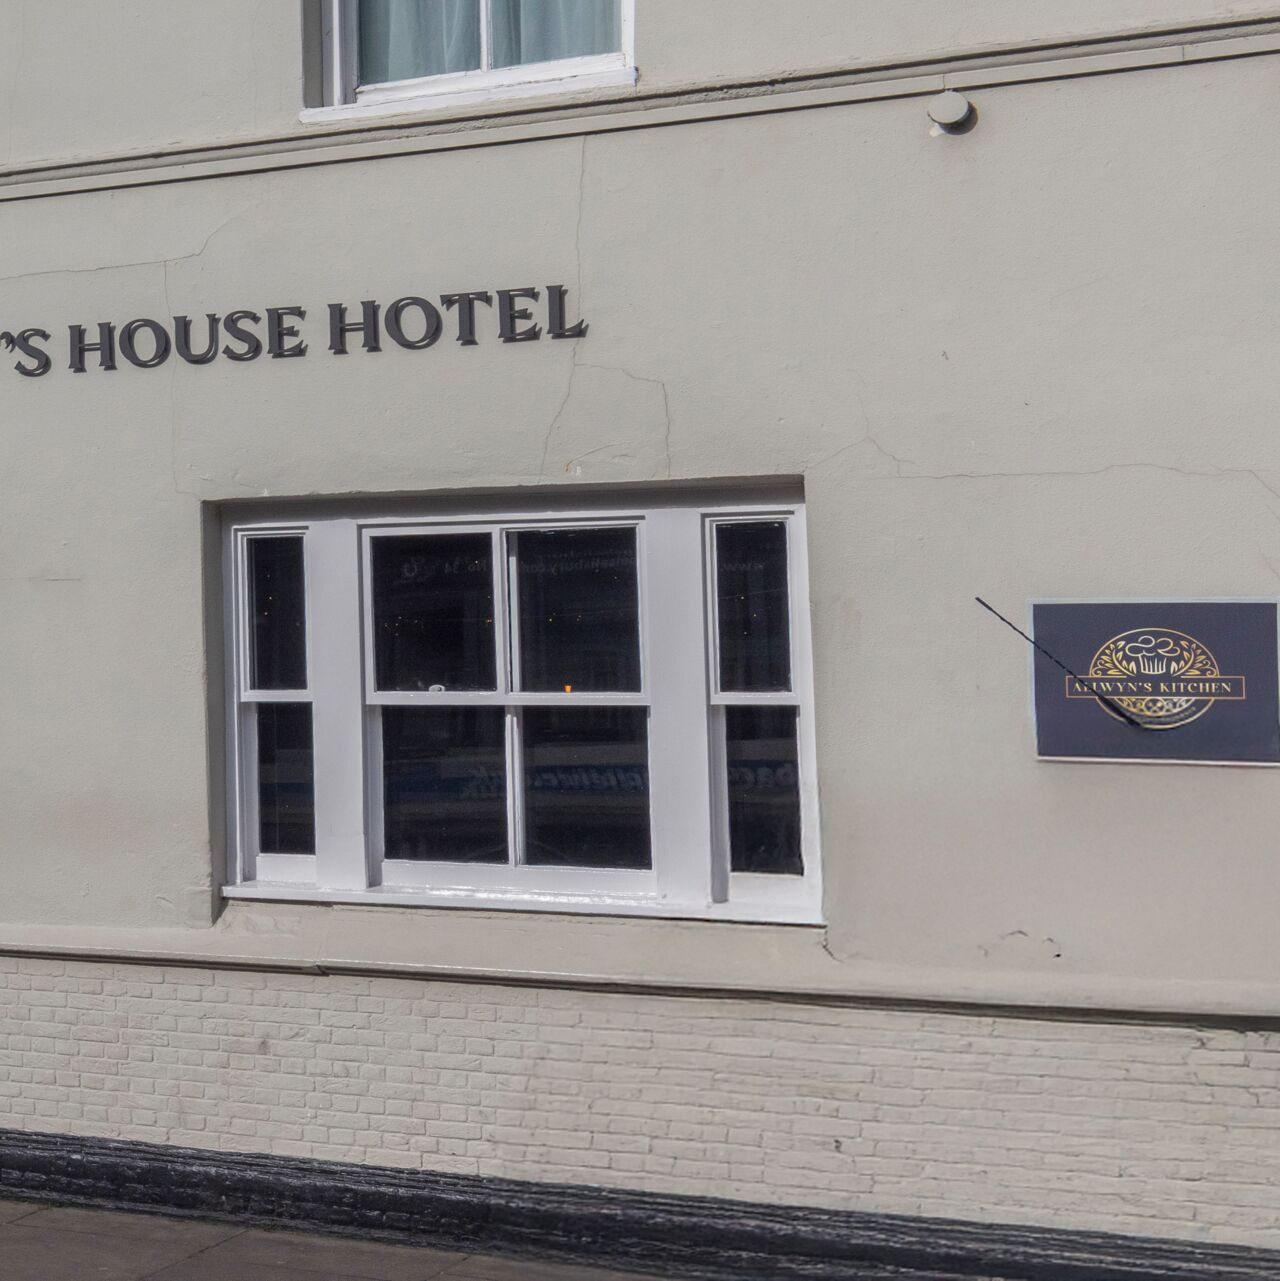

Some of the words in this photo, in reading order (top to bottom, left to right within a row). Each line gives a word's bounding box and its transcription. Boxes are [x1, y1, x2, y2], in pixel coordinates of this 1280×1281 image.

[68, 305, 309, 373] HOUSE
[327, 284, 589, 356] HOTEL
[1159, 682, 1232, 693] KITCHEN
